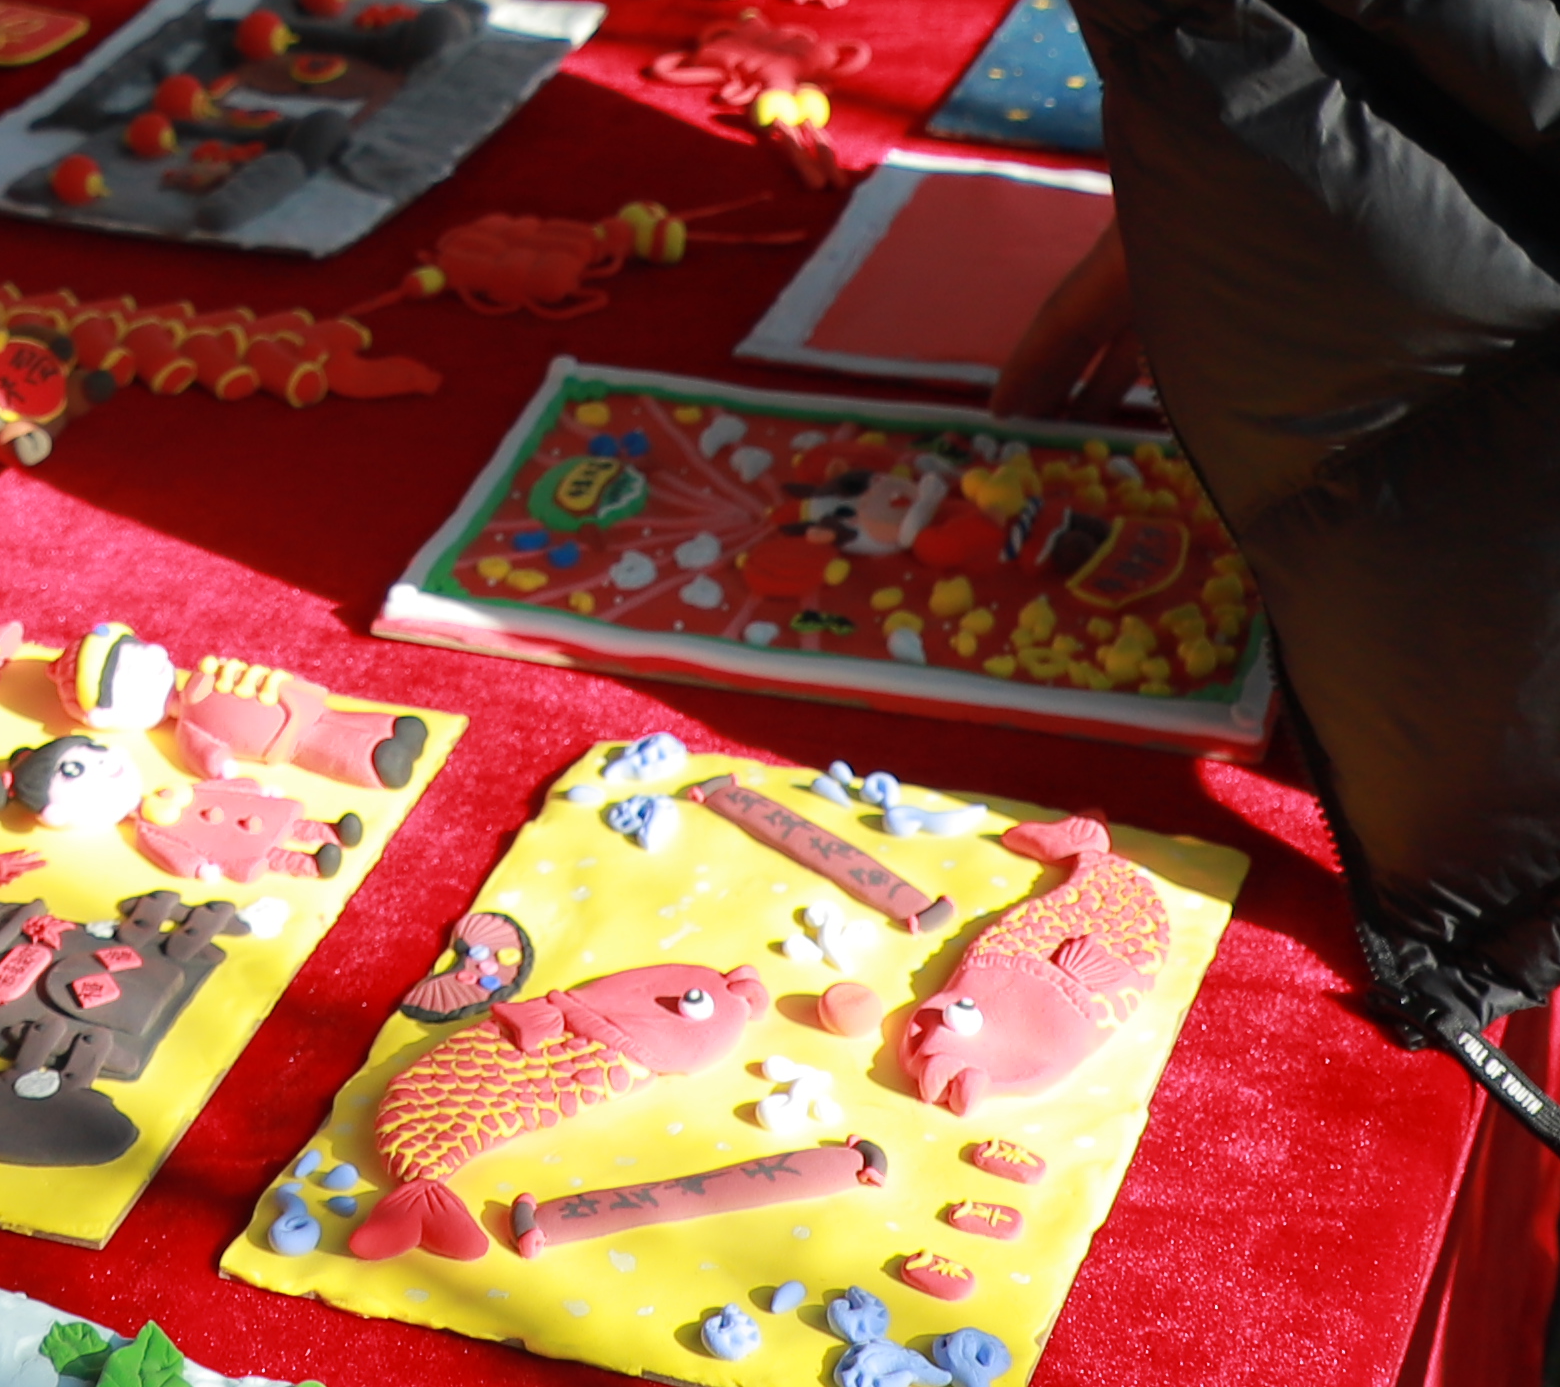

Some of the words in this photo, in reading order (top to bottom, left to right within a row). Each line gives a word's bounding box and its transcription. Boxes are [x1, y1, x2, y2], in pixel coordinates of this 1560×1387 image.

[1457, 1030, 1489, 1067] FULL
[1484, 1058, 1507, 1080] OF
[1501, 1072, 1545, 1115] YOUTH
